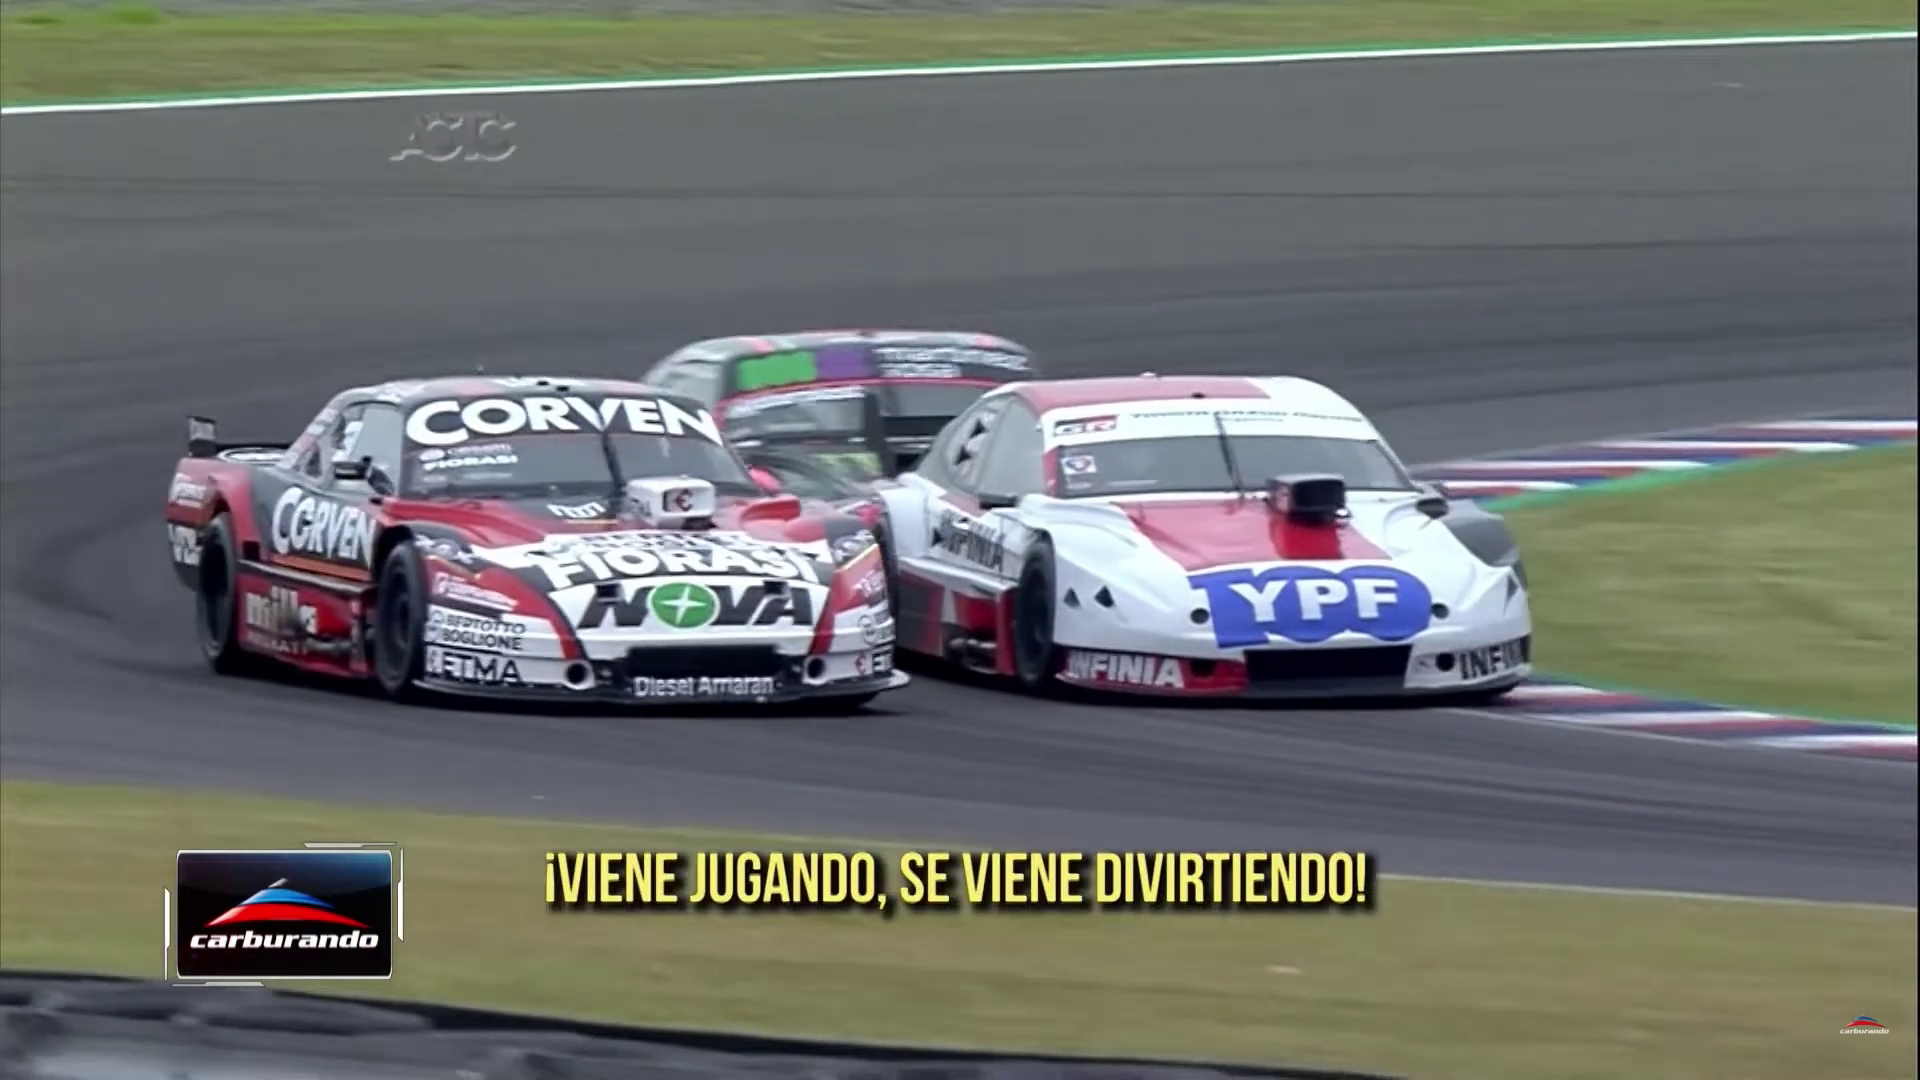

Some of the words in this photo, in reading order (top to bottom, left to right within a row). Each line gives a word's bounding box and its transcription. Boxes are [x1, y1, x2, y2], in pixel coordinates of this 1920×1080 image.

[406, 396, 723, 446] CORVEN
[423, 455, 519, 472] FIORASI
[272, 486, 377, 570] CORVEN
[537, 546, 820, 592] FIORASI
[577, 581, 813, 629] NOVA
[1228, 578, 1400, 623] YPF
[441, 629, 523, 650] BOGLIONE
